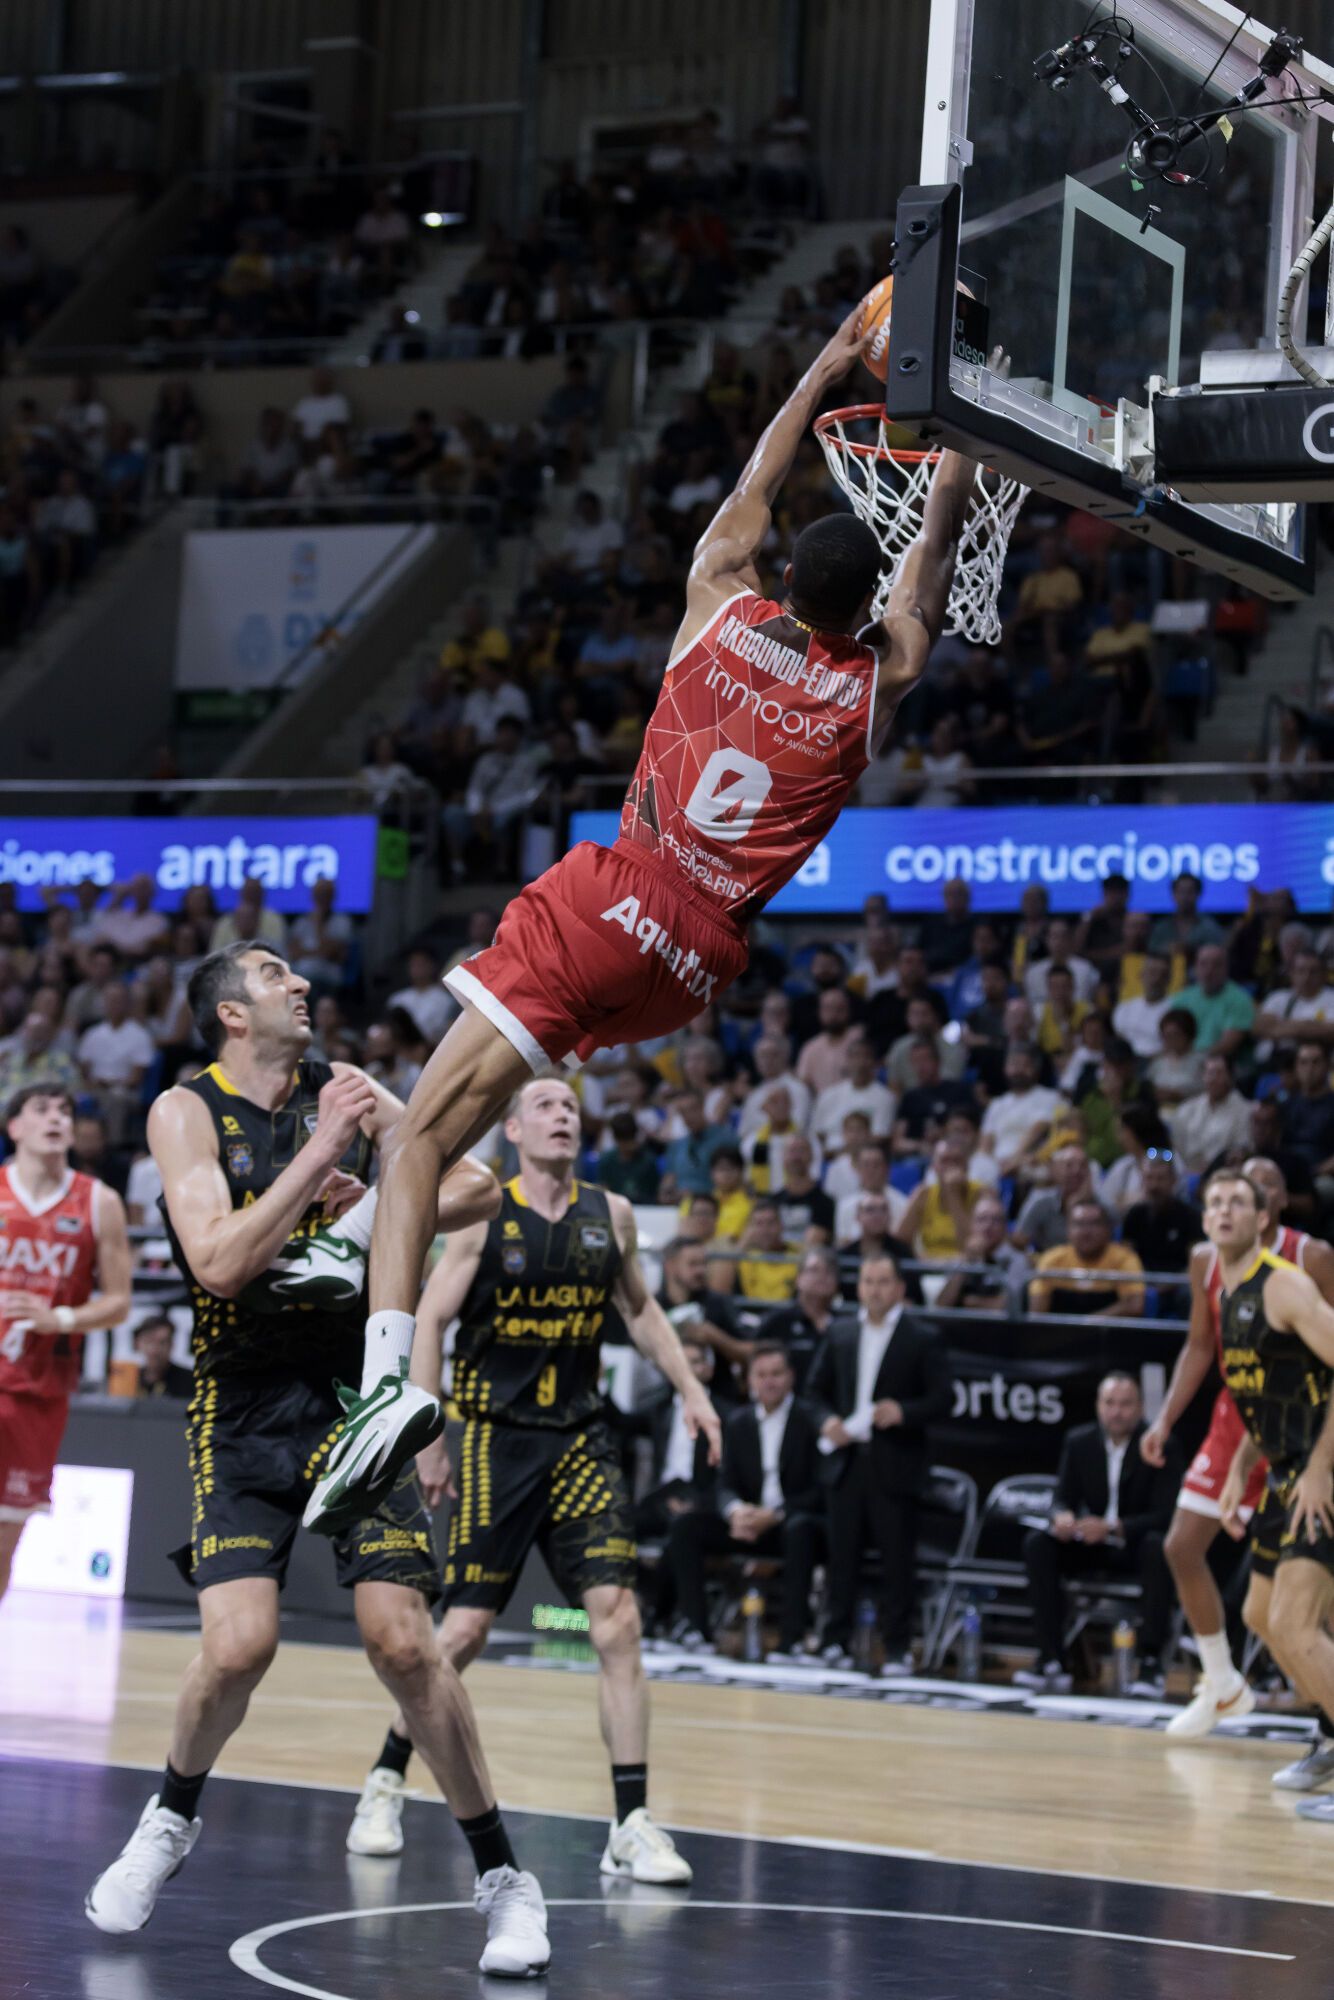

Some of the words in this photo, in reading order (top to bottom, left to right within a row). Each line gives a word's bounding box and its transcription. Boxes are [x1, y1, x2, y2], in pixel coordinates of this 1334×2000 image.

[684, 747, 773, 841] 0
[0, 840, 115, 886] iones
[157, 836, 339, 889] antara
[885, 830, 1260, 883] construcciones
